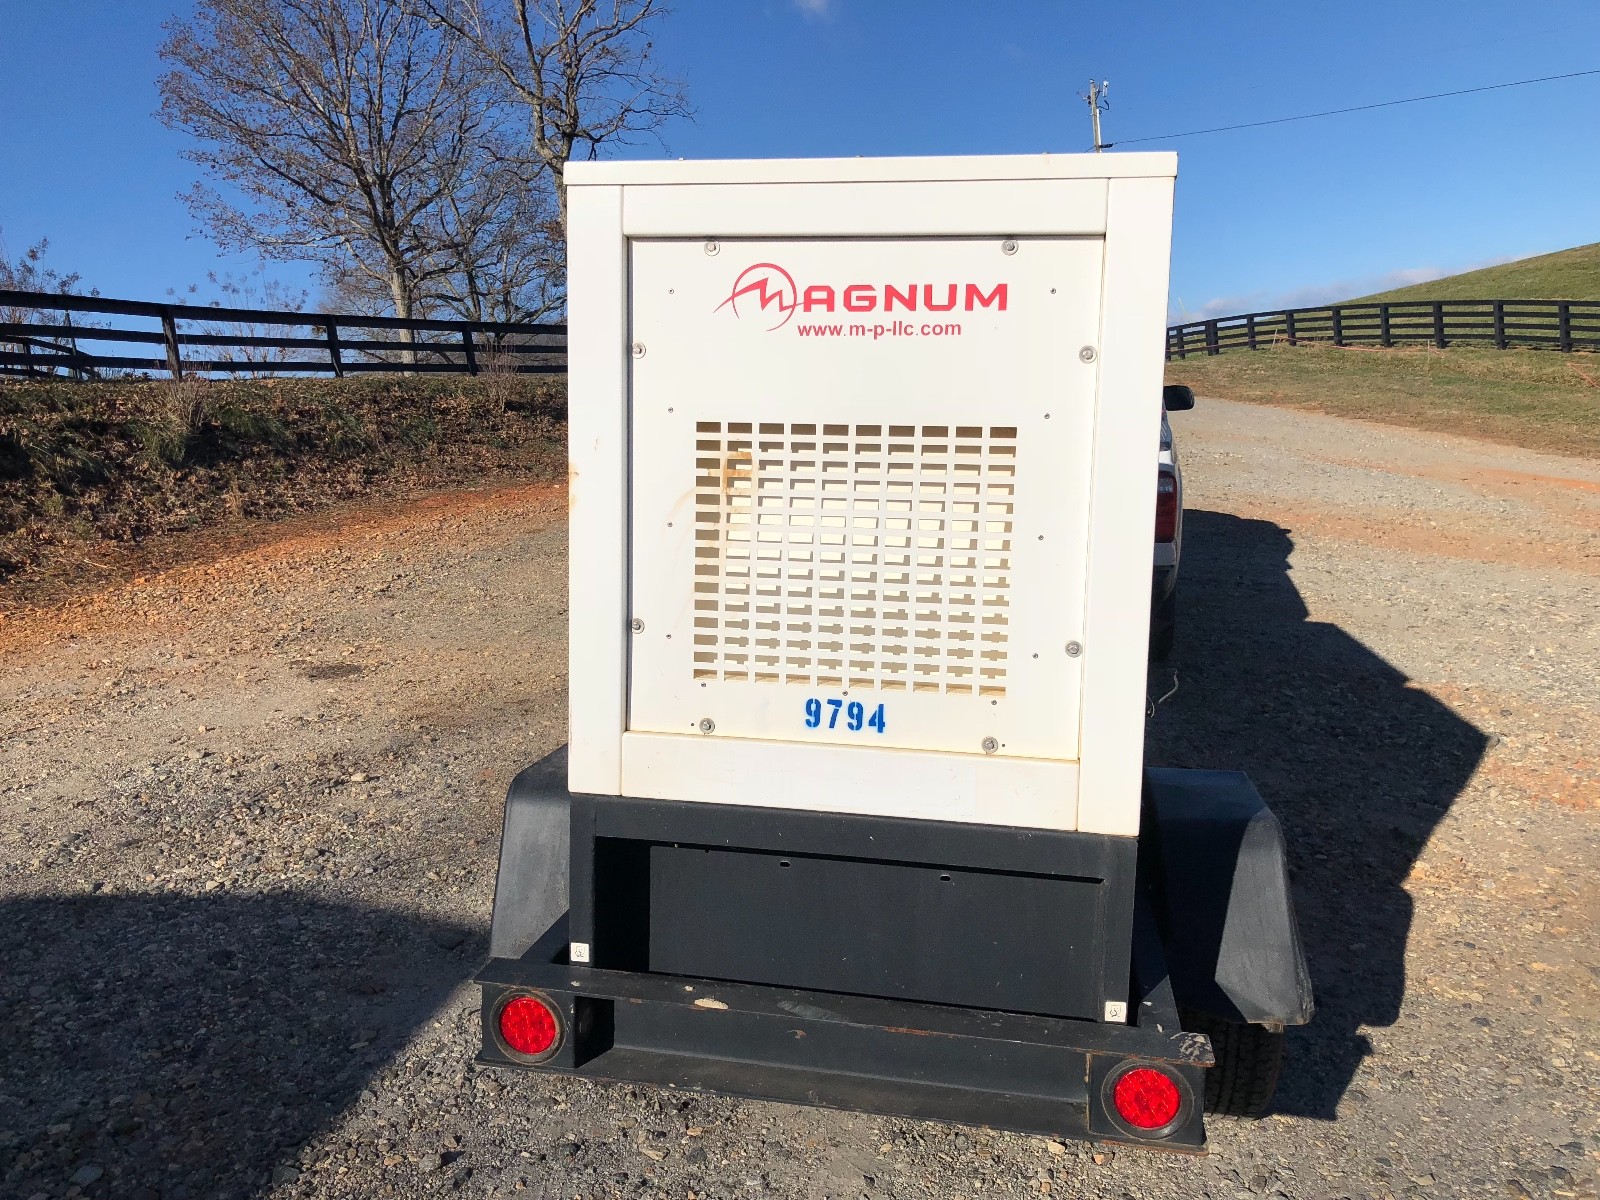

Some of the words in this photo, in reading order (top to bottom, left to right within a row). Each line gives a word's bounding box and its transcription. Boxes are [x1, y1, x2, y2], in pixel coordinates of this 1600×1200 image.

[713, 263, 1008, 318] MAGNUM
[797, 321, 962, 340] www.m-p-llc.com
[805, 698, 886, 733] 9794
